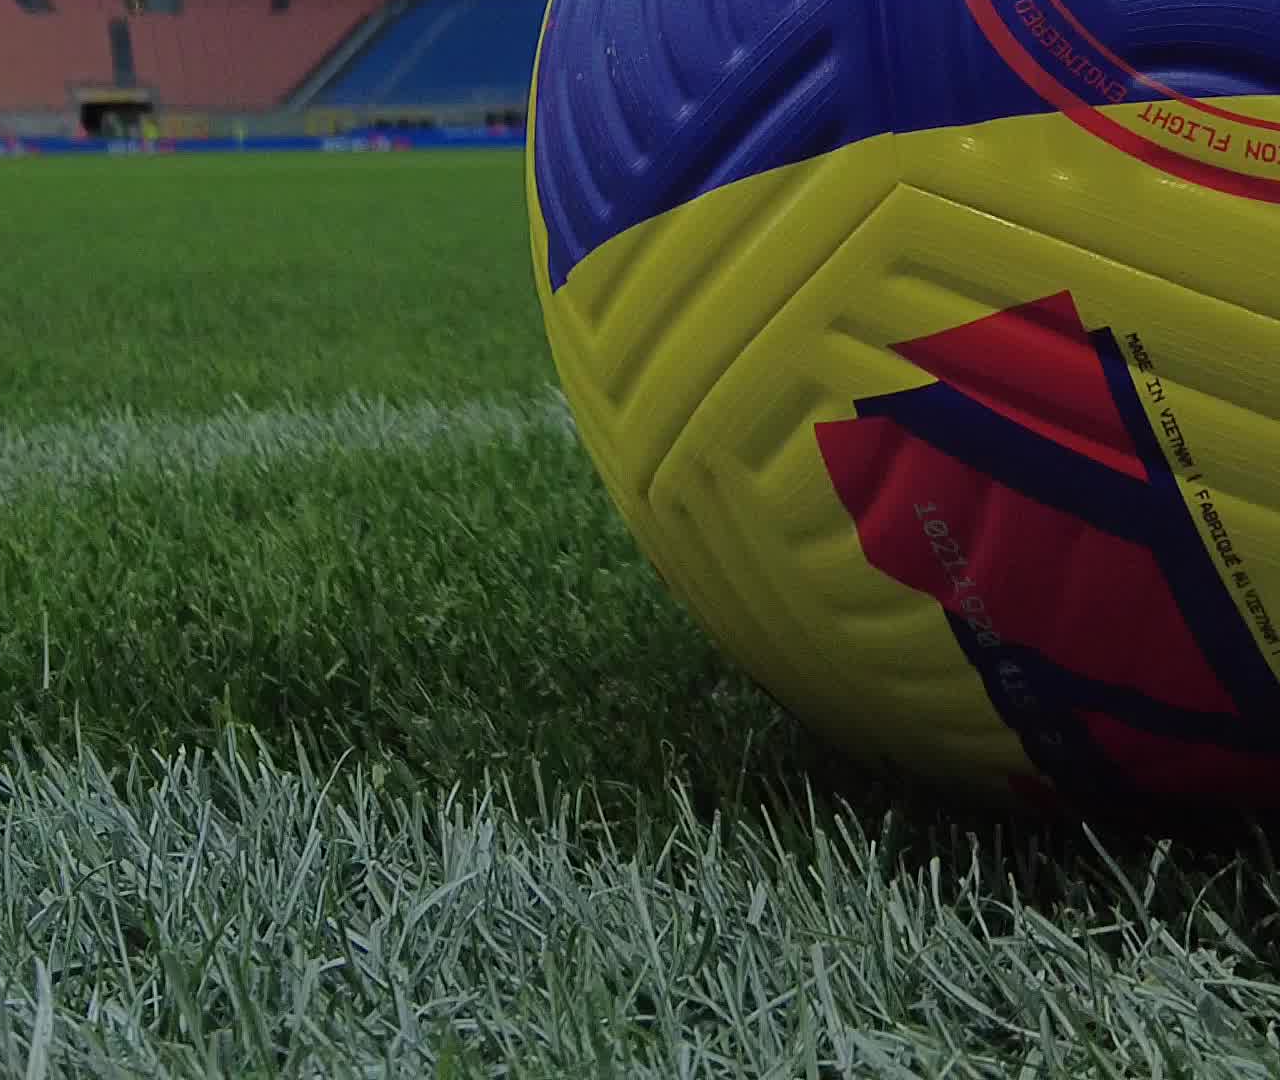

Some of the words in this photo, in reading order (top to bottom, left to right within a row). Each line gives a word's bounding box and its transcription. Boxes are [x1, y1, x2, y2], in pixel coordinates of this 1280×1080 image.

[1137, 102, 1232, 153] FLIGHT
[1124, 332, 1154, 373] MADE
[1146, 377, 1166, 404] IN
[1160, 407, 1195, 468] VIETNAM
[1194, 488, 1244, 569] FABRIQUÉ
